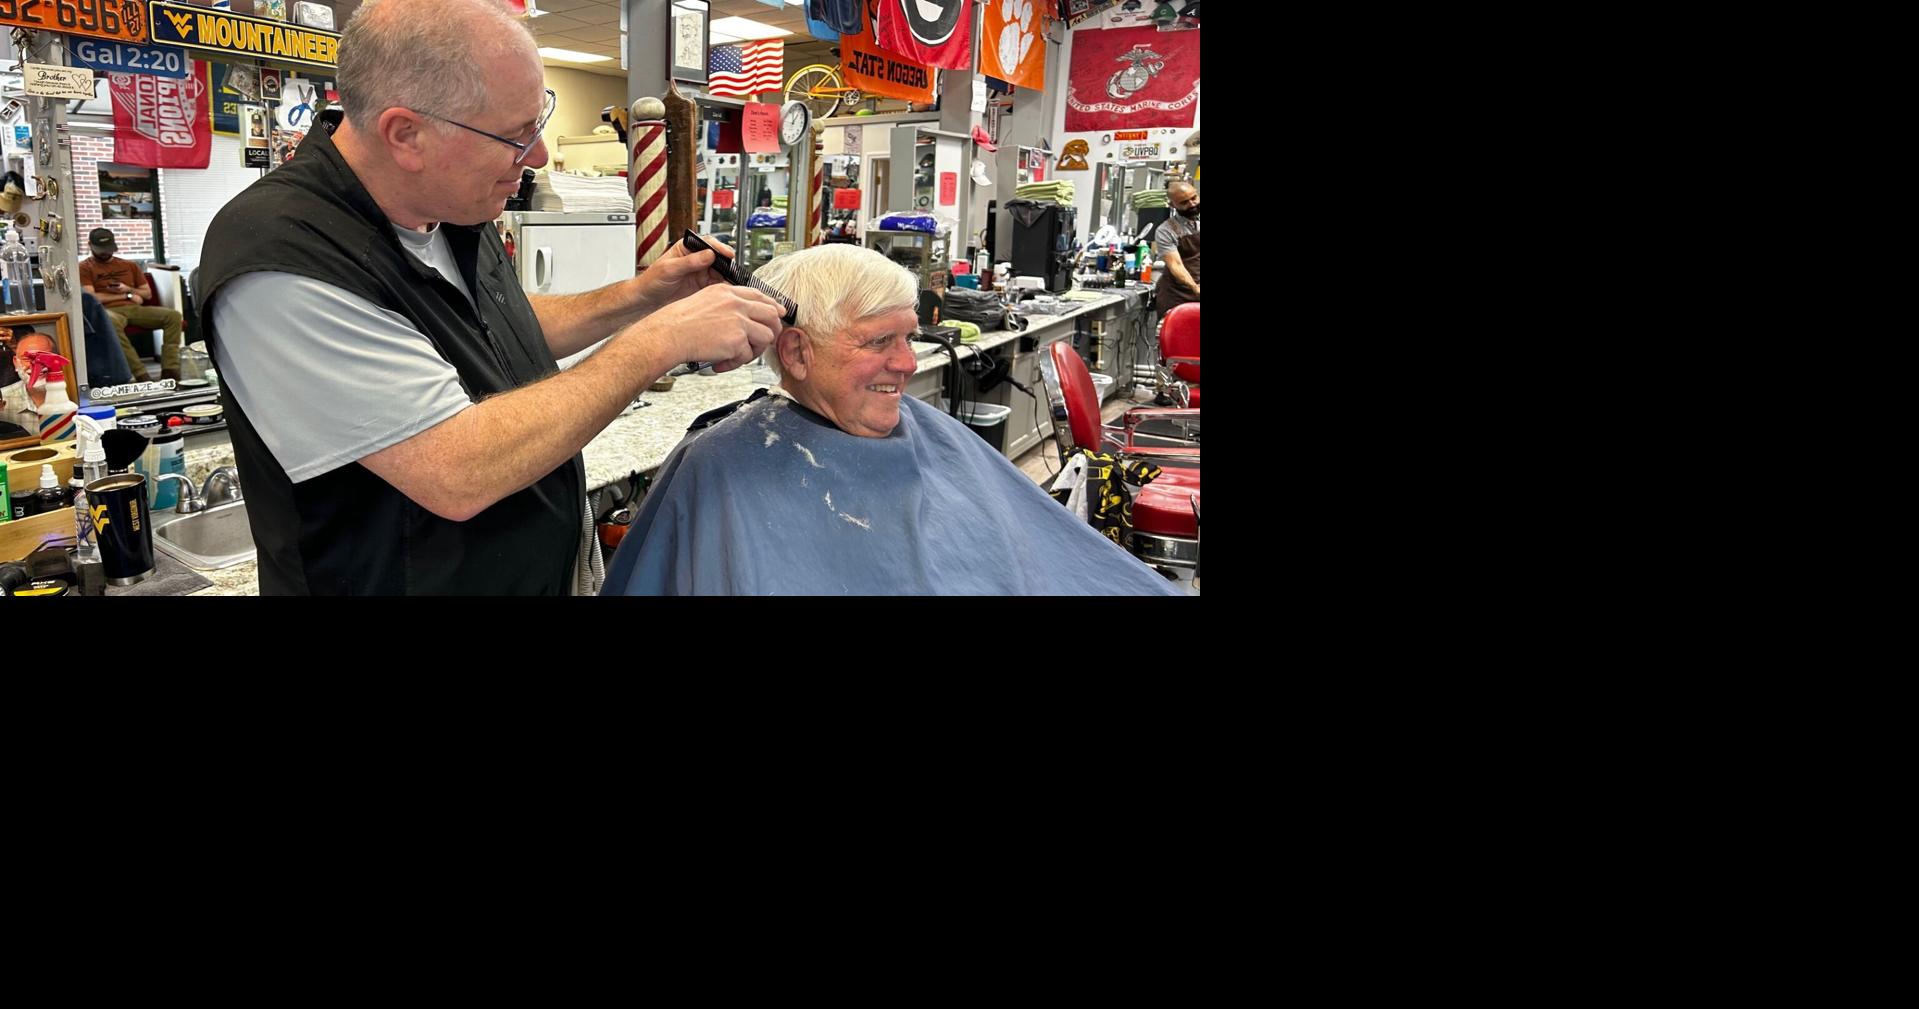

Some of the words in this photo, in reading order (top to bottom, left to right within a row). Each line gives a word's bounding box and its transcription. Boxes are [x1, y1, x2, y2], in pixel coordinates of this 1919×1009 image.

[197, 13, 340, 64] MOUNTAINEER
[77, 41, 122, 65] Gal
[127, 47, 180, 72] 2:20
[37, 70, 67, 82] Brother
[1094, 102, 1126, 113] STATES
[1130, 100, 1161, 113] MARINE
[1167, 91, 1199, 110] CORPS
